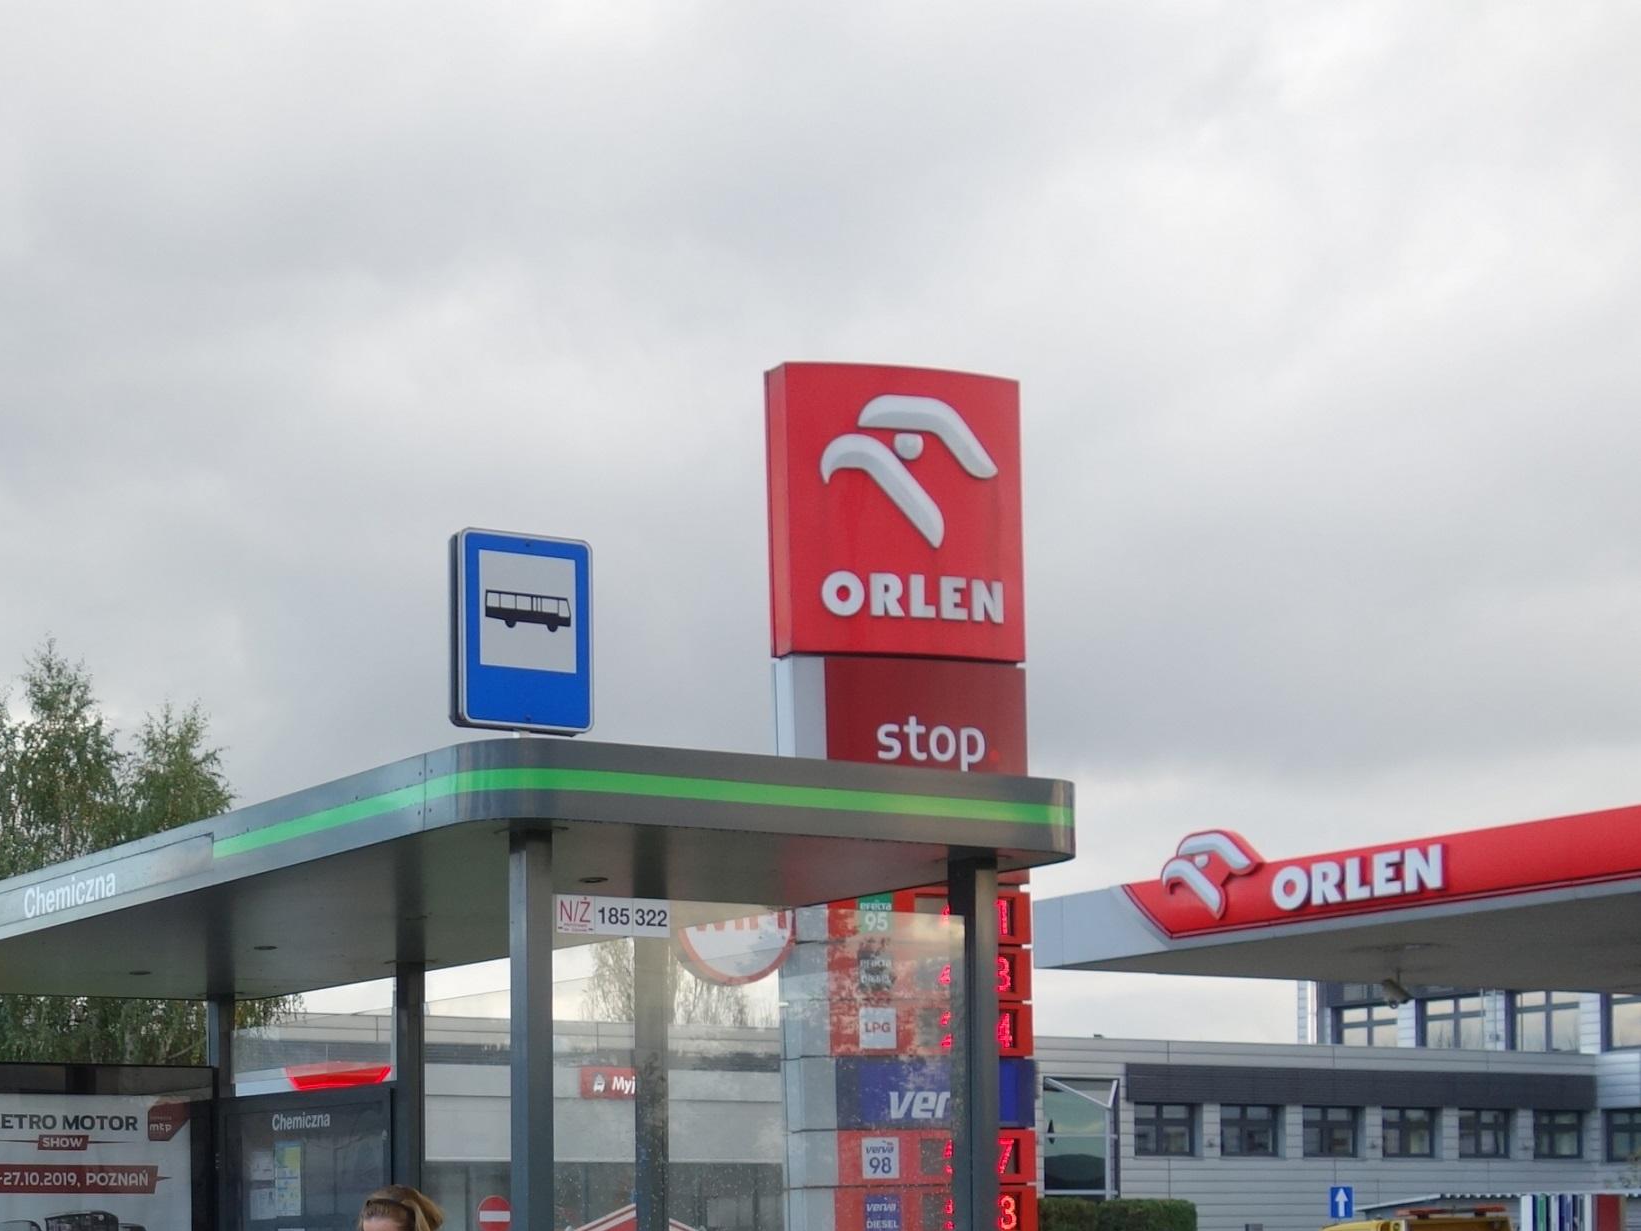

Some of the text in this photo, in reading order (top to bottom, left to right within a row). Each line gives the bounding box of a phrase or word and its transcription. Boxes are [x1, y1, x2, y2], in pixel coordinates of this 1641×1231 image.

[821, 570, 1005, 624] ORLEN
[1272, 843, 1445, 911] ORLEN
[23, 872, 116, 919] Chemiczna
[598, 906, 631, 925] 185
[635, 908, 668, 928] 322
[864, 913, 889, 932] 95
[864, 1022, 892, 1033] LPG
[612, 1075, 637, 1095] Myj
[889, 1090, 951, 1119] ver
[62, 1115, 138, 1131] MOTOR
[272, 1111, 331, 1131] Chemiczna
[42, 1137, 84, 1148] SHOW
[869, 1157, 892, 1174] 98
[86, 1170, 149, 1186] POZNAŃ
[866, 1220, 899, 1229] DIESEL
